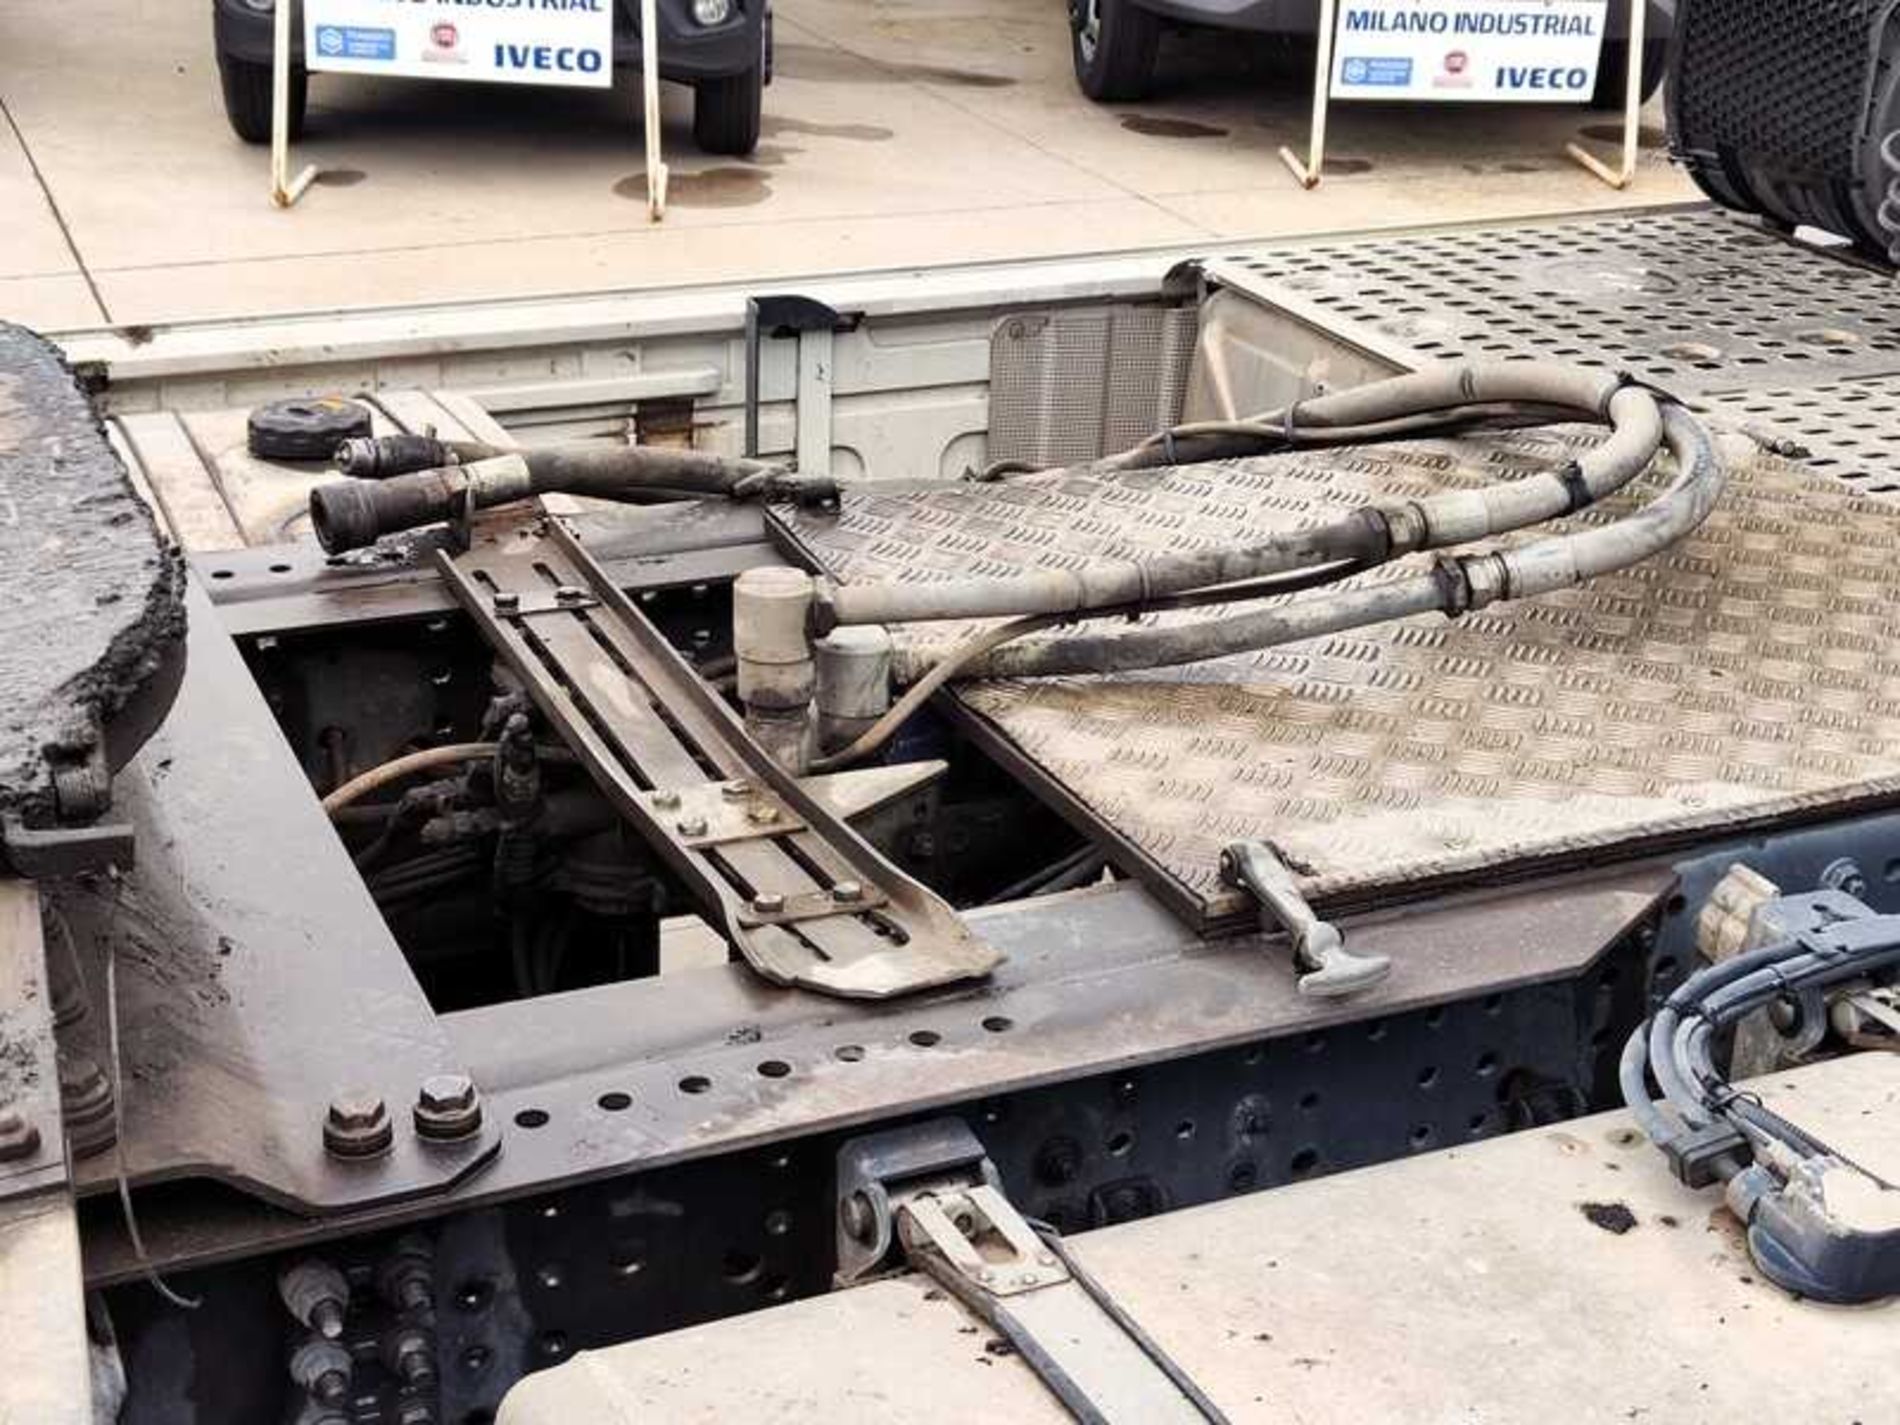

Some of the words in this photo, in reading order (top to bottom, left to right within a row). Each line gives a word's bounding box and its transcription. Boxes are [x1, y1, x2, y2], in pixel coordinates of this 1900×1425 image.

[1345, 11, 1448, 33] MILANO
[1454, 13, 1596, 36] INDUSTRIAL
[494, 44, 602, 73] IVECO
[1495, 67, 1588, 89] IVECO
